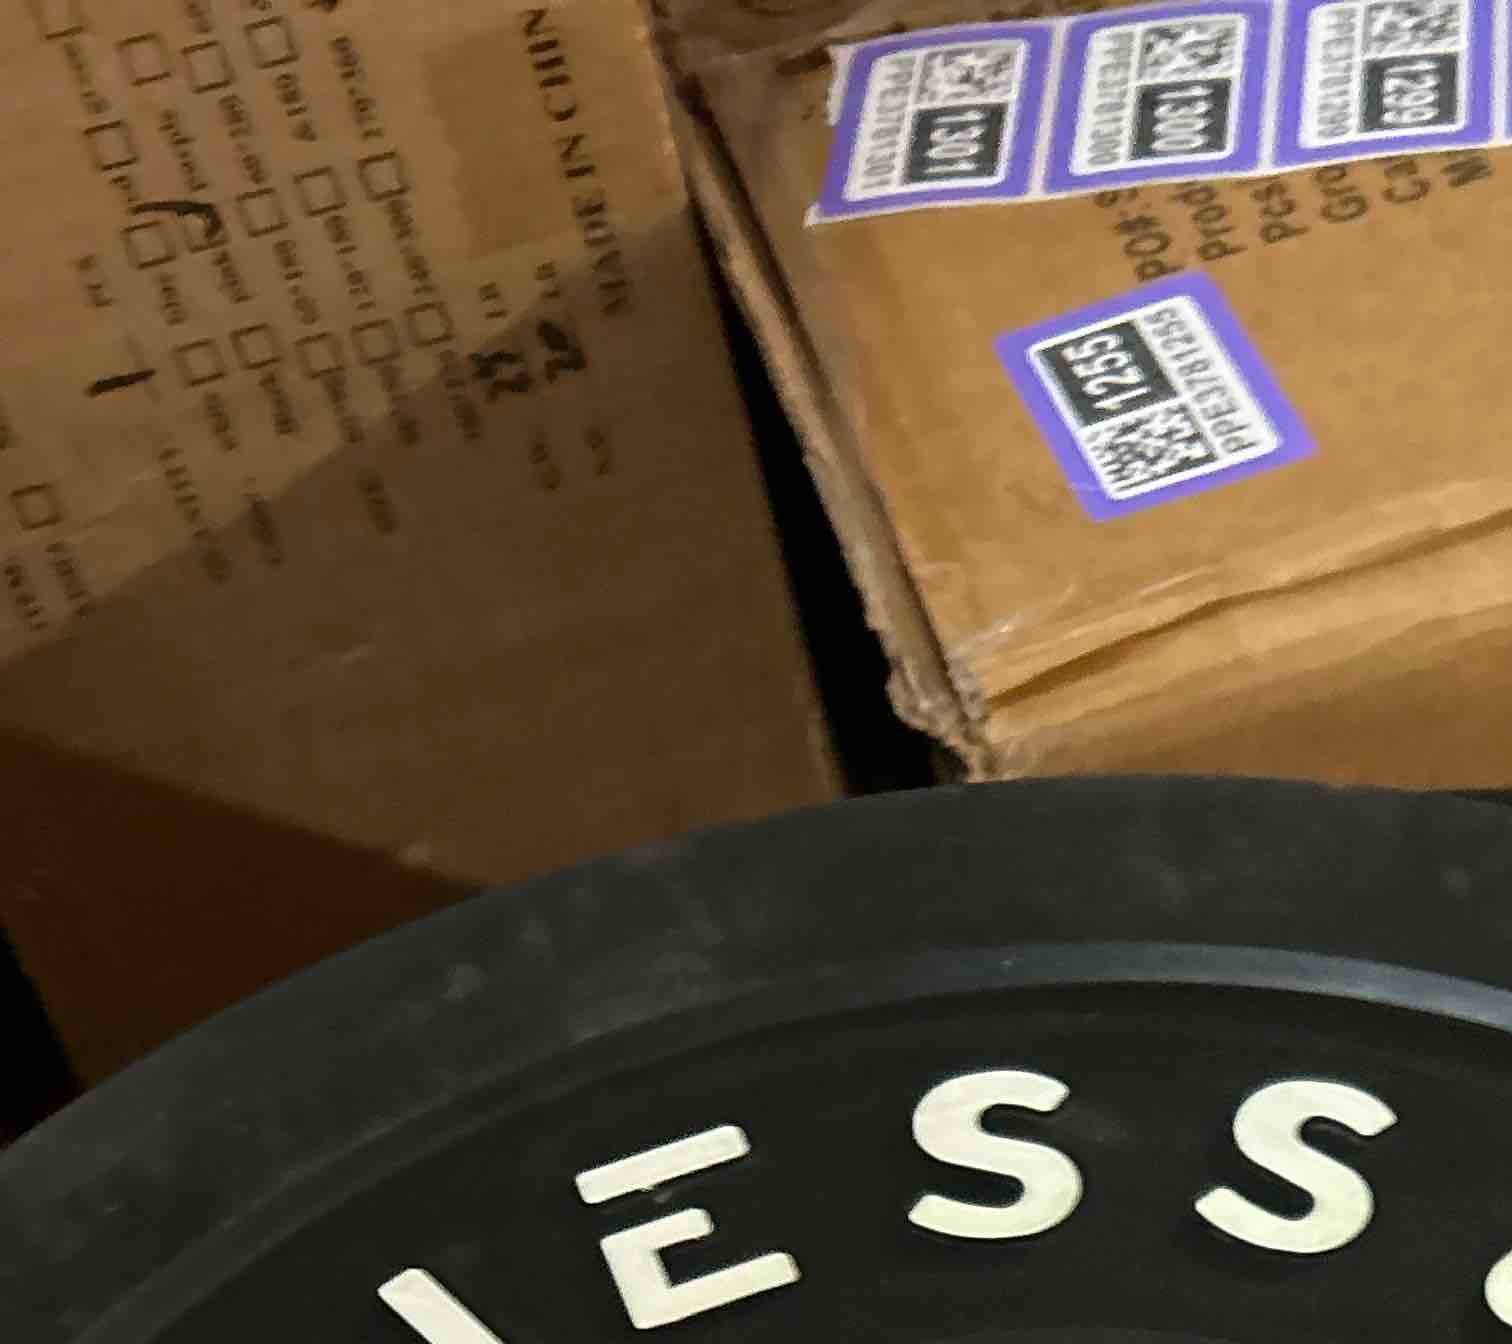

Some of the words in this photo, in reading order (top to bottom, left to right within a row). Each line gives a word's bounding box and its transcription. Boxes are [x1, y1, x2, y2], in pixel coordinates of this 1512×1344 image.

[1151, 77, 1215, 154] 1300
[1378, 54, 1440, 128] 1299
[555, 133, 597, 184] IN
[925, 108, 989, 176] 1301
[576, 194, 633, 315] MADE
[1170, 180, 1247, 262] Prod
[1065, 333, 1151, 413] 1255
